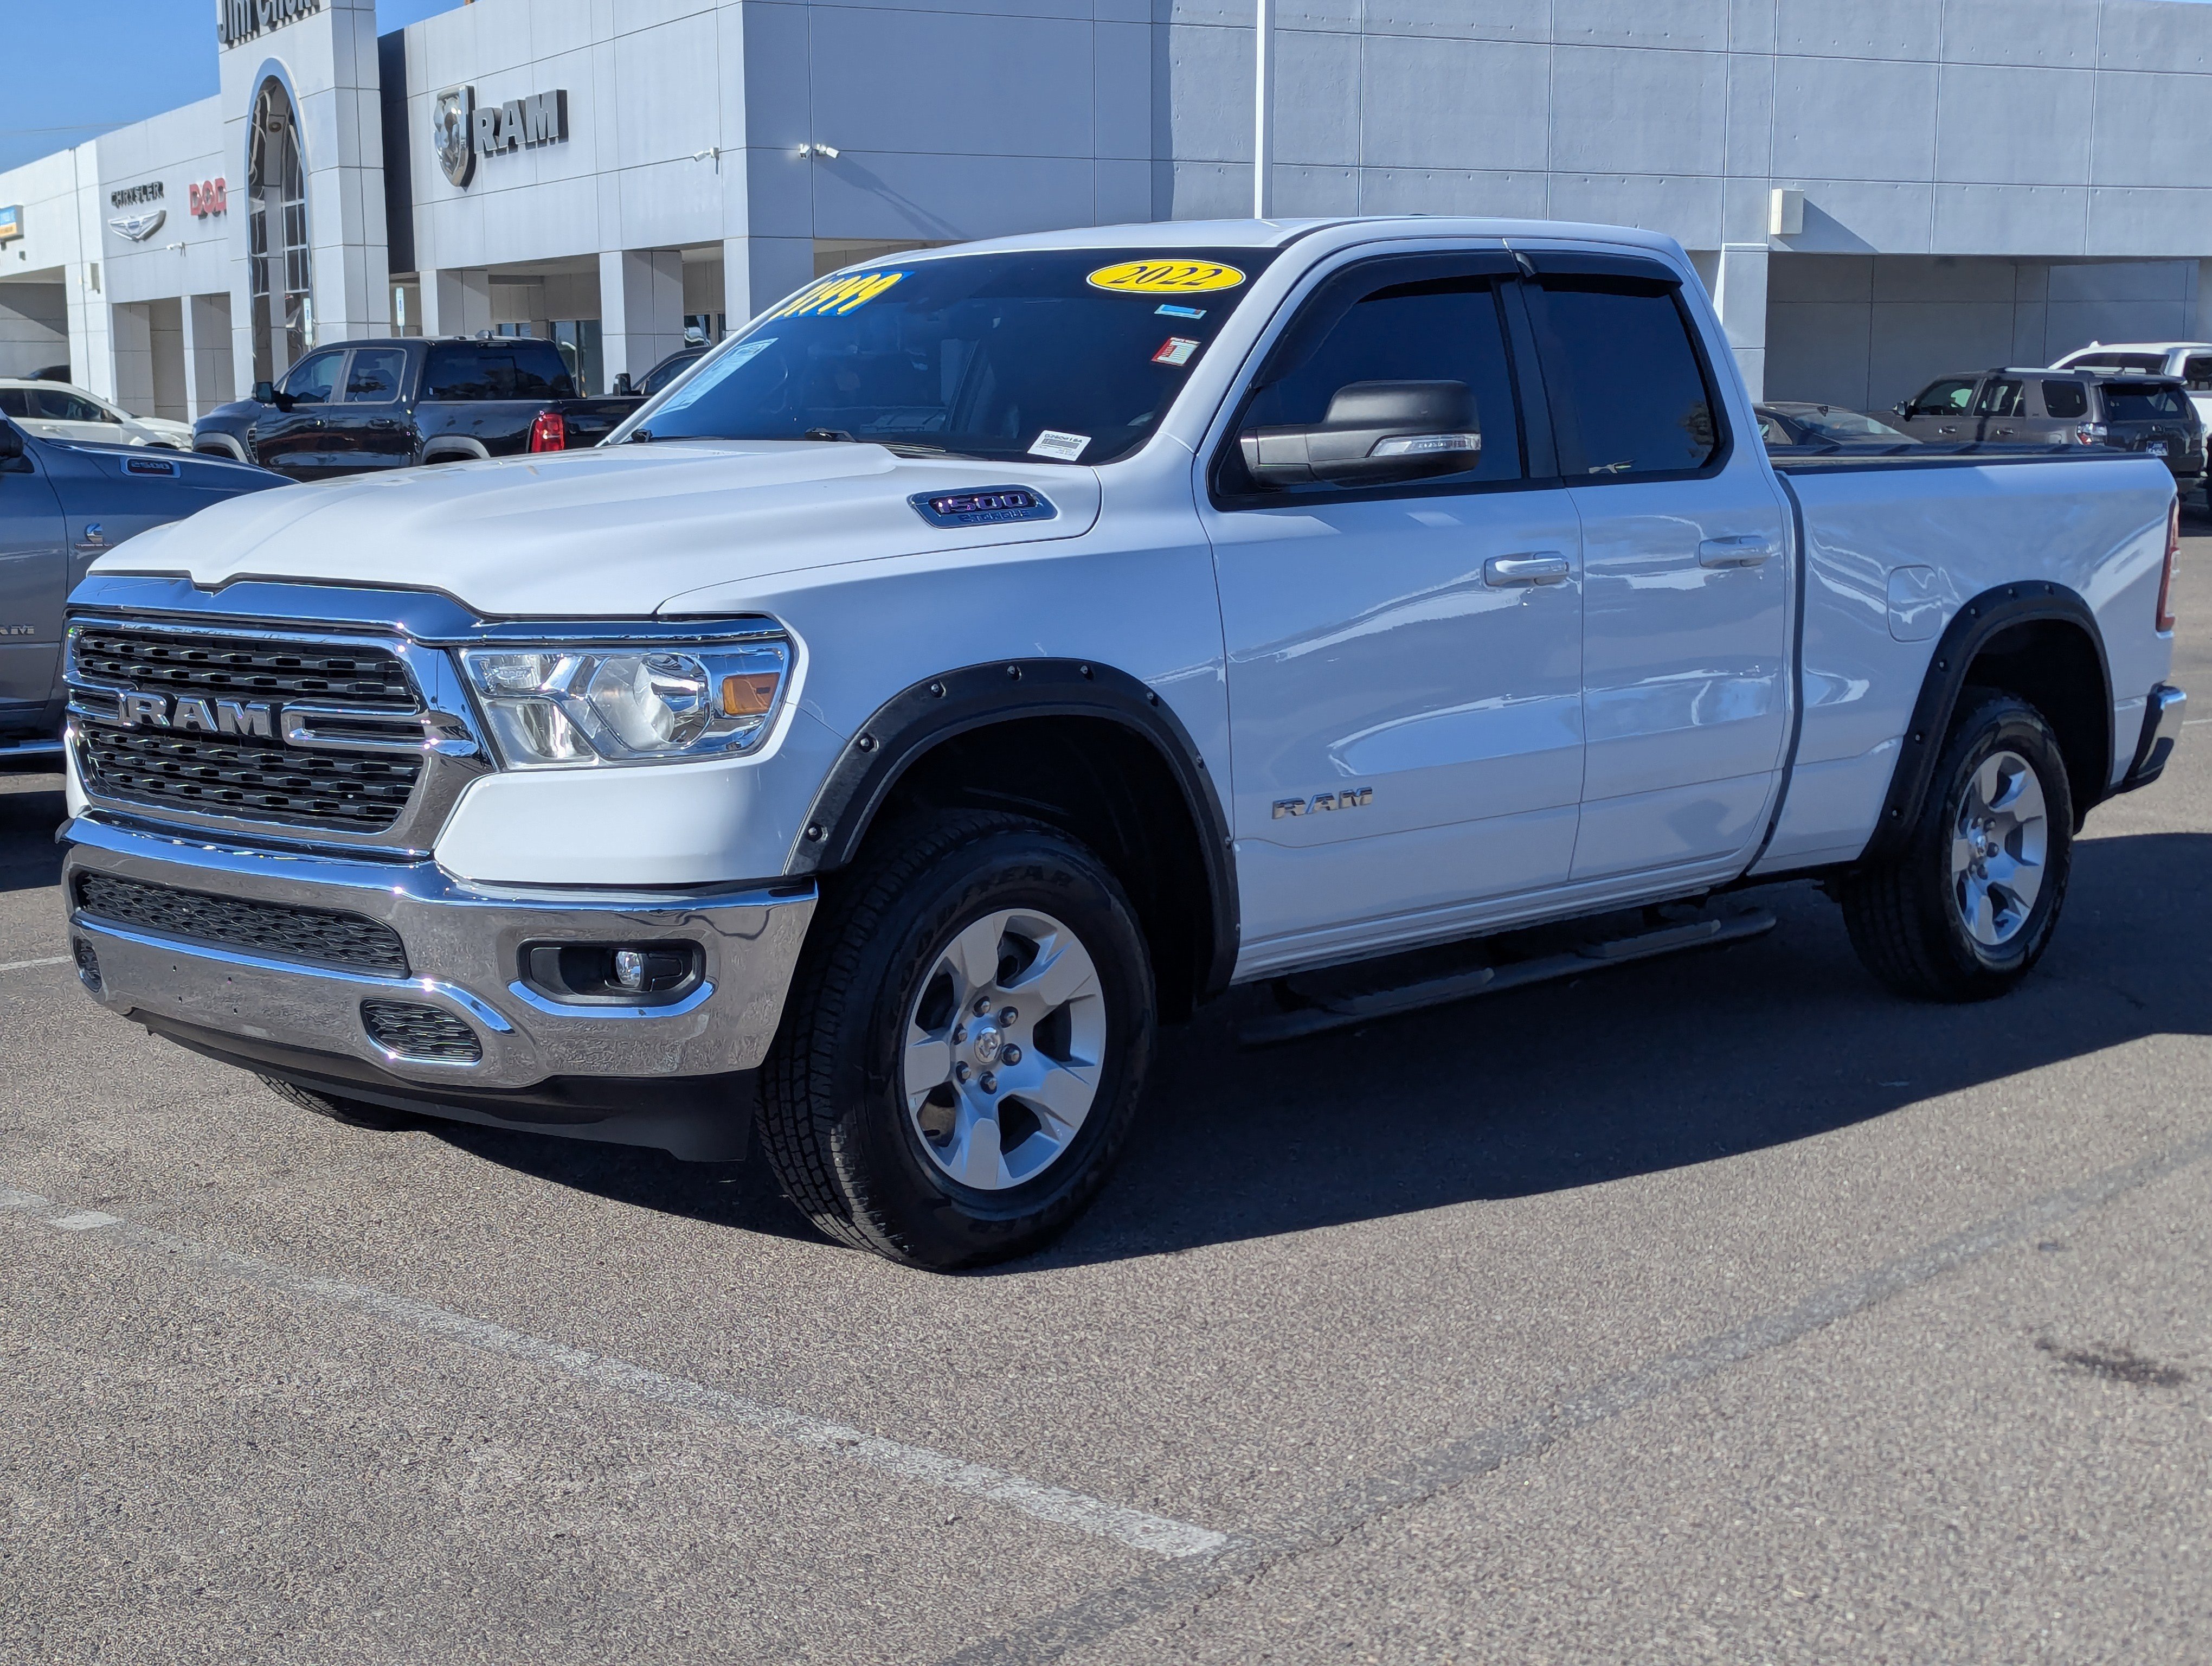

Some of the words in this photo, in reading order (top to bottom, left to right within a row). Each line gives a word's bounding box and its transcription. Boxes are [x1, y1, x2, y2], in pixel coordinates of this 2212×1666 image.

[472, 89, 565, 156] RAM
[111, 181, 163, 208] CHRYSLER
[1106, 266, 1223, 286] 2022
[934, 493, 1028, 514] 1500
[126, 691, 272, 738] RAM
[1272, 787, 1373, 819] RAM
